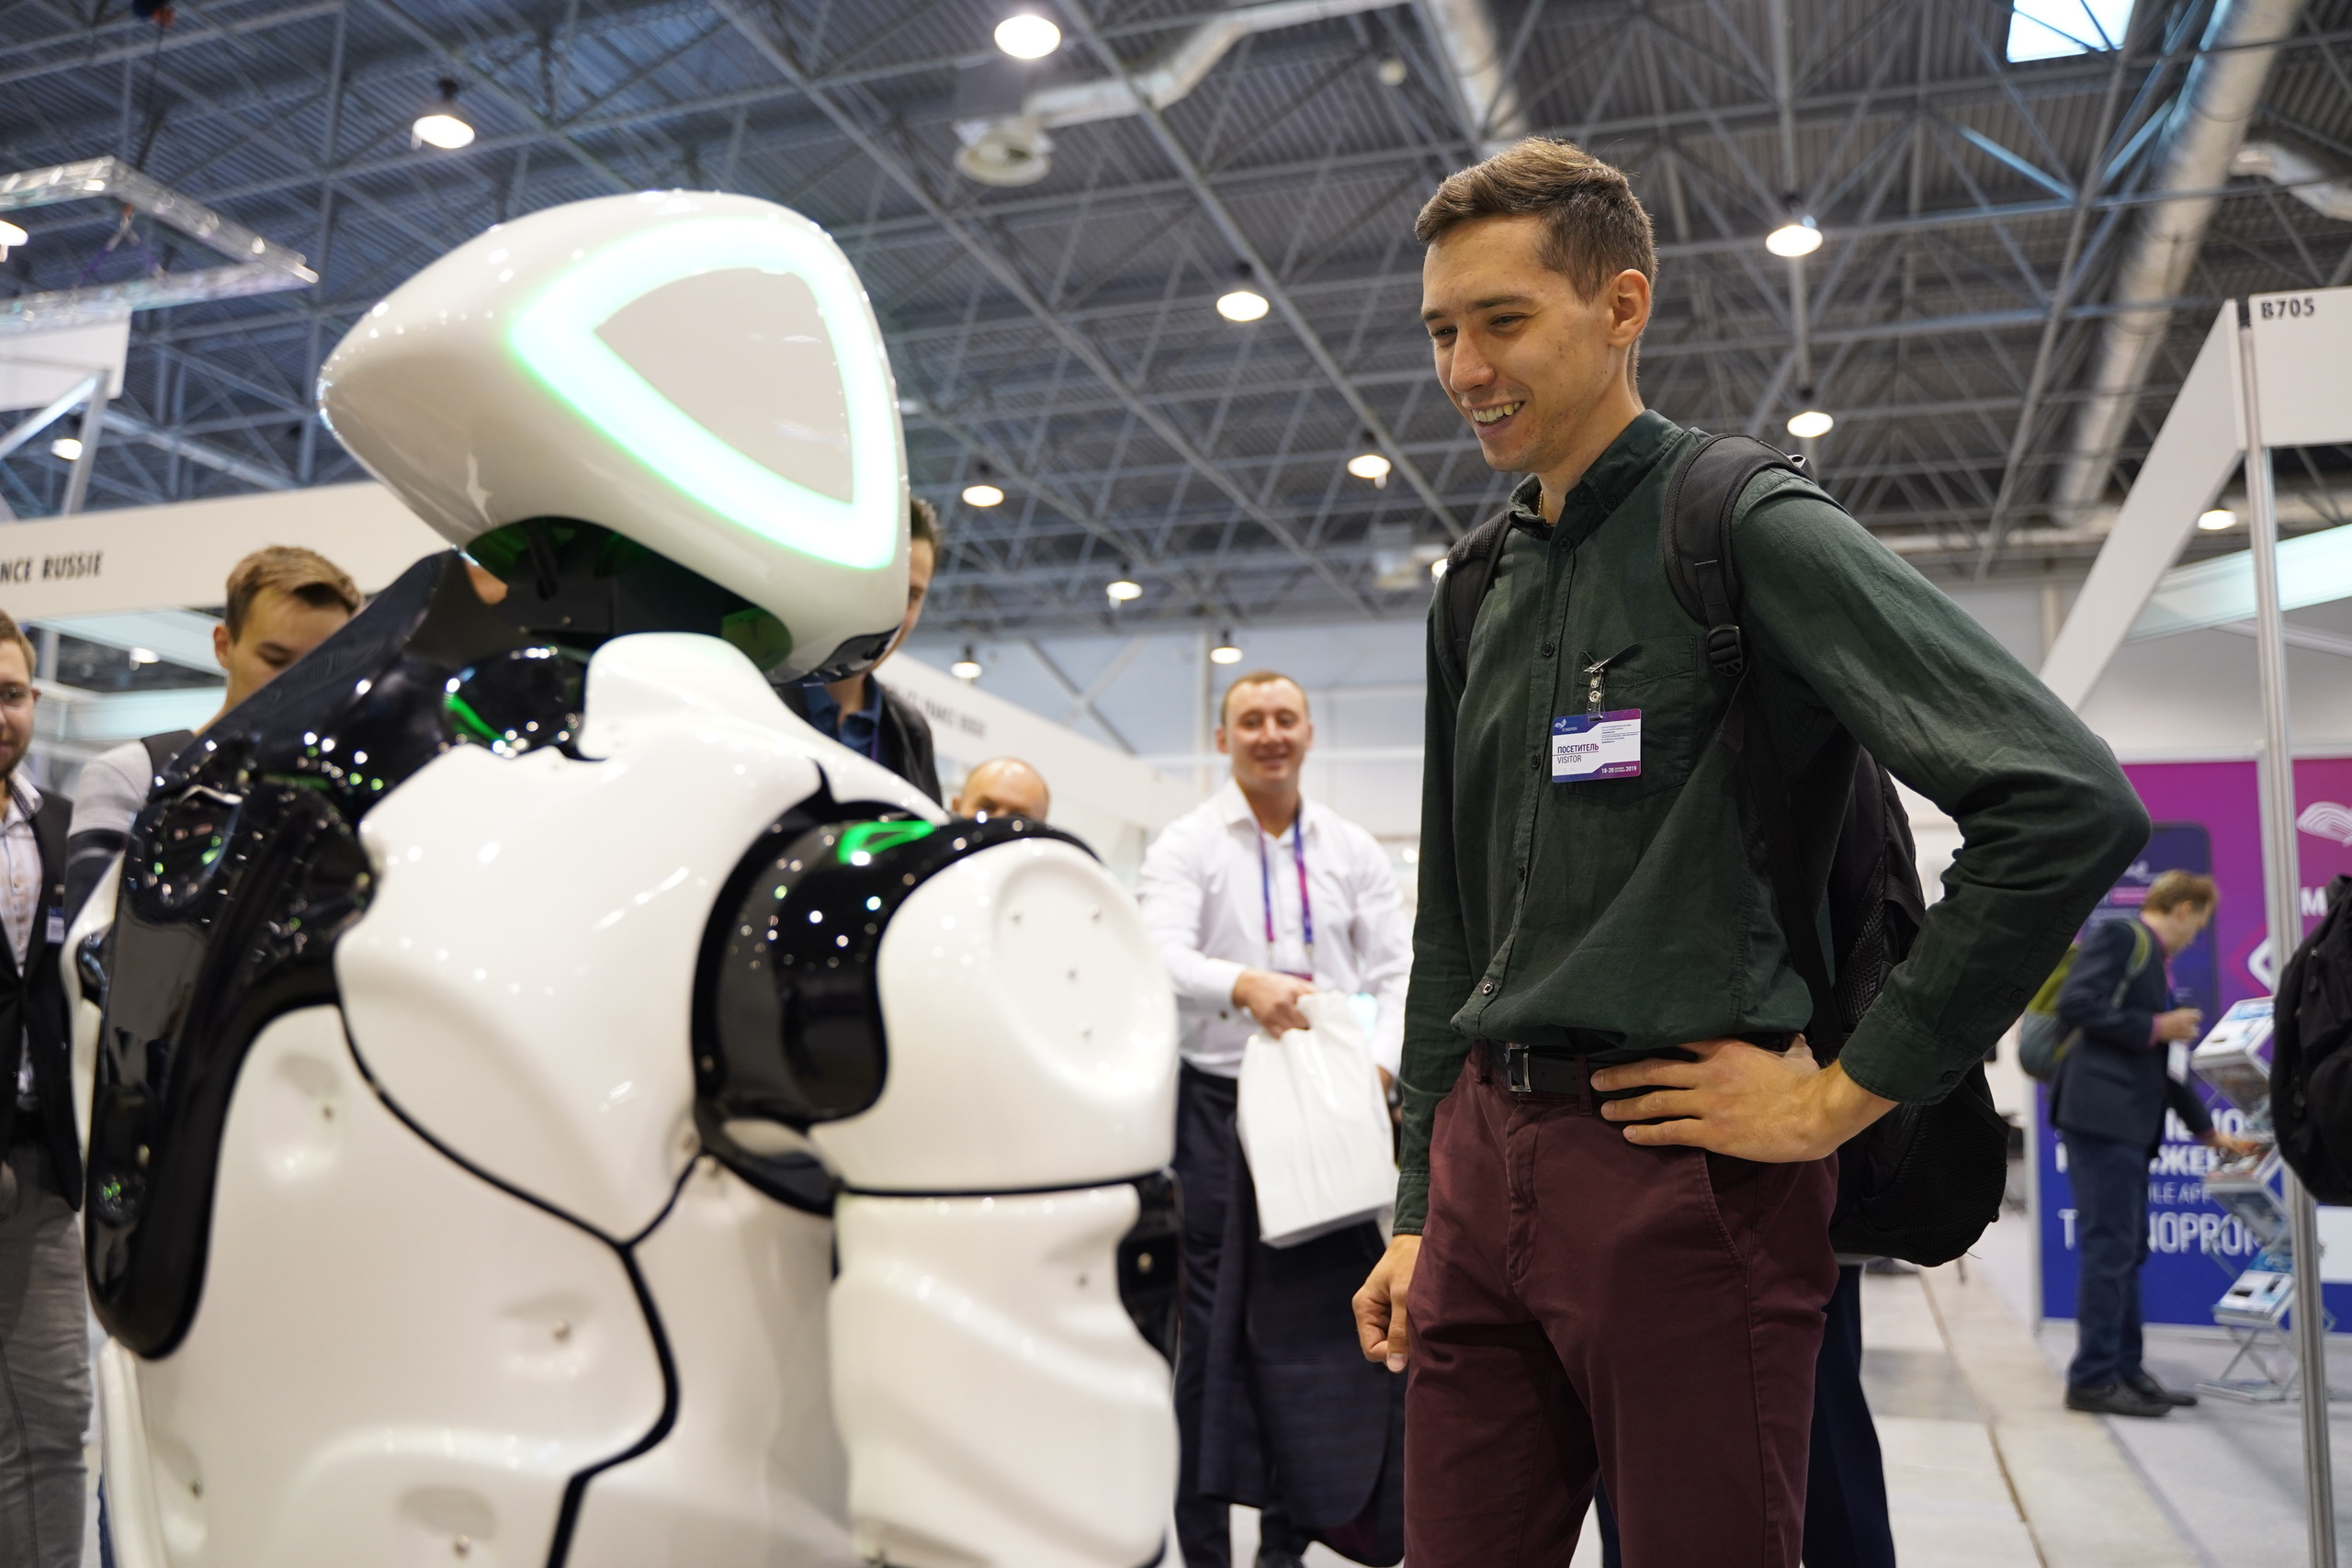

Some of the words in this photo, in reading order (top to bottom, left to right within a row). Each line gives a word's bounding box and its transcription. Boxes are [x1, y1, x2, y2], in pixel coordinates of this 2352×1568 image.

[2260, 297, 2315, 320] B705
[42, 551, 104, 580] RUSSIE
[1557, 743, 1600, 754] ПОСЕТИТЕЛЬ
[1557, 755, 1582, 764] VISITOR
